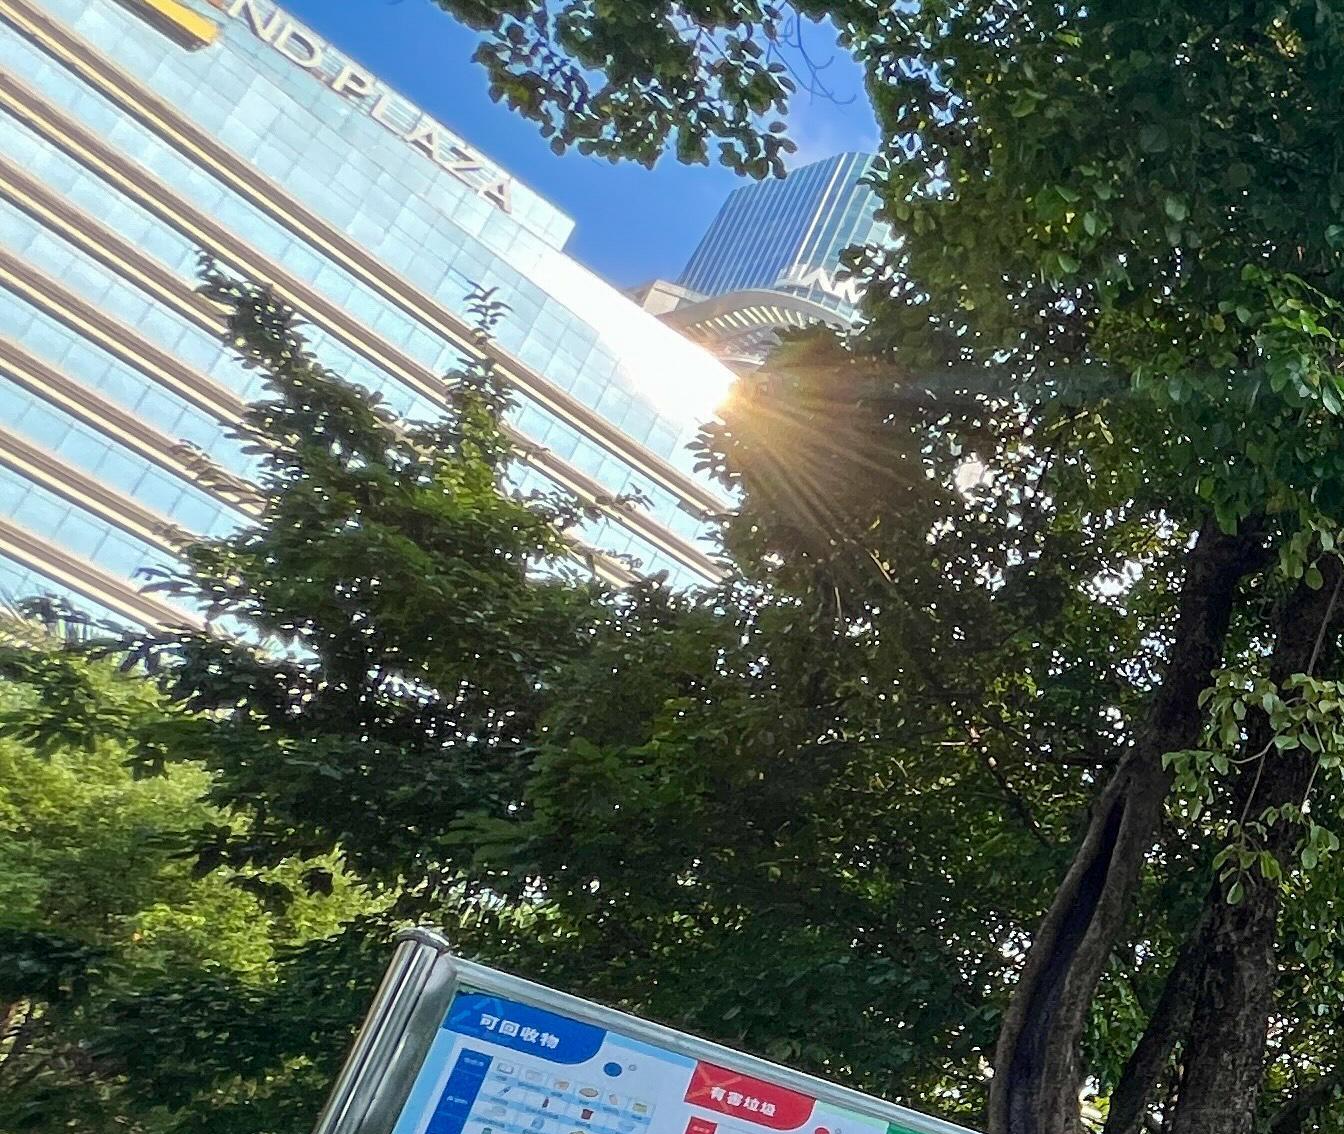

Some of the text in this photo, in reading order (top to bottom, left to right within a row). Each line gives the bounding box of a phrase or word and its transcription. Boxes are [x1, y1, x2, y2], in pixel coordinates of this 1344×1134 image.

[331, 65, 513, 214] PLAZA
[479, 1013, 560, 1049] 可回收物
[710, 1086, 777, 1117] 有害垃圾
